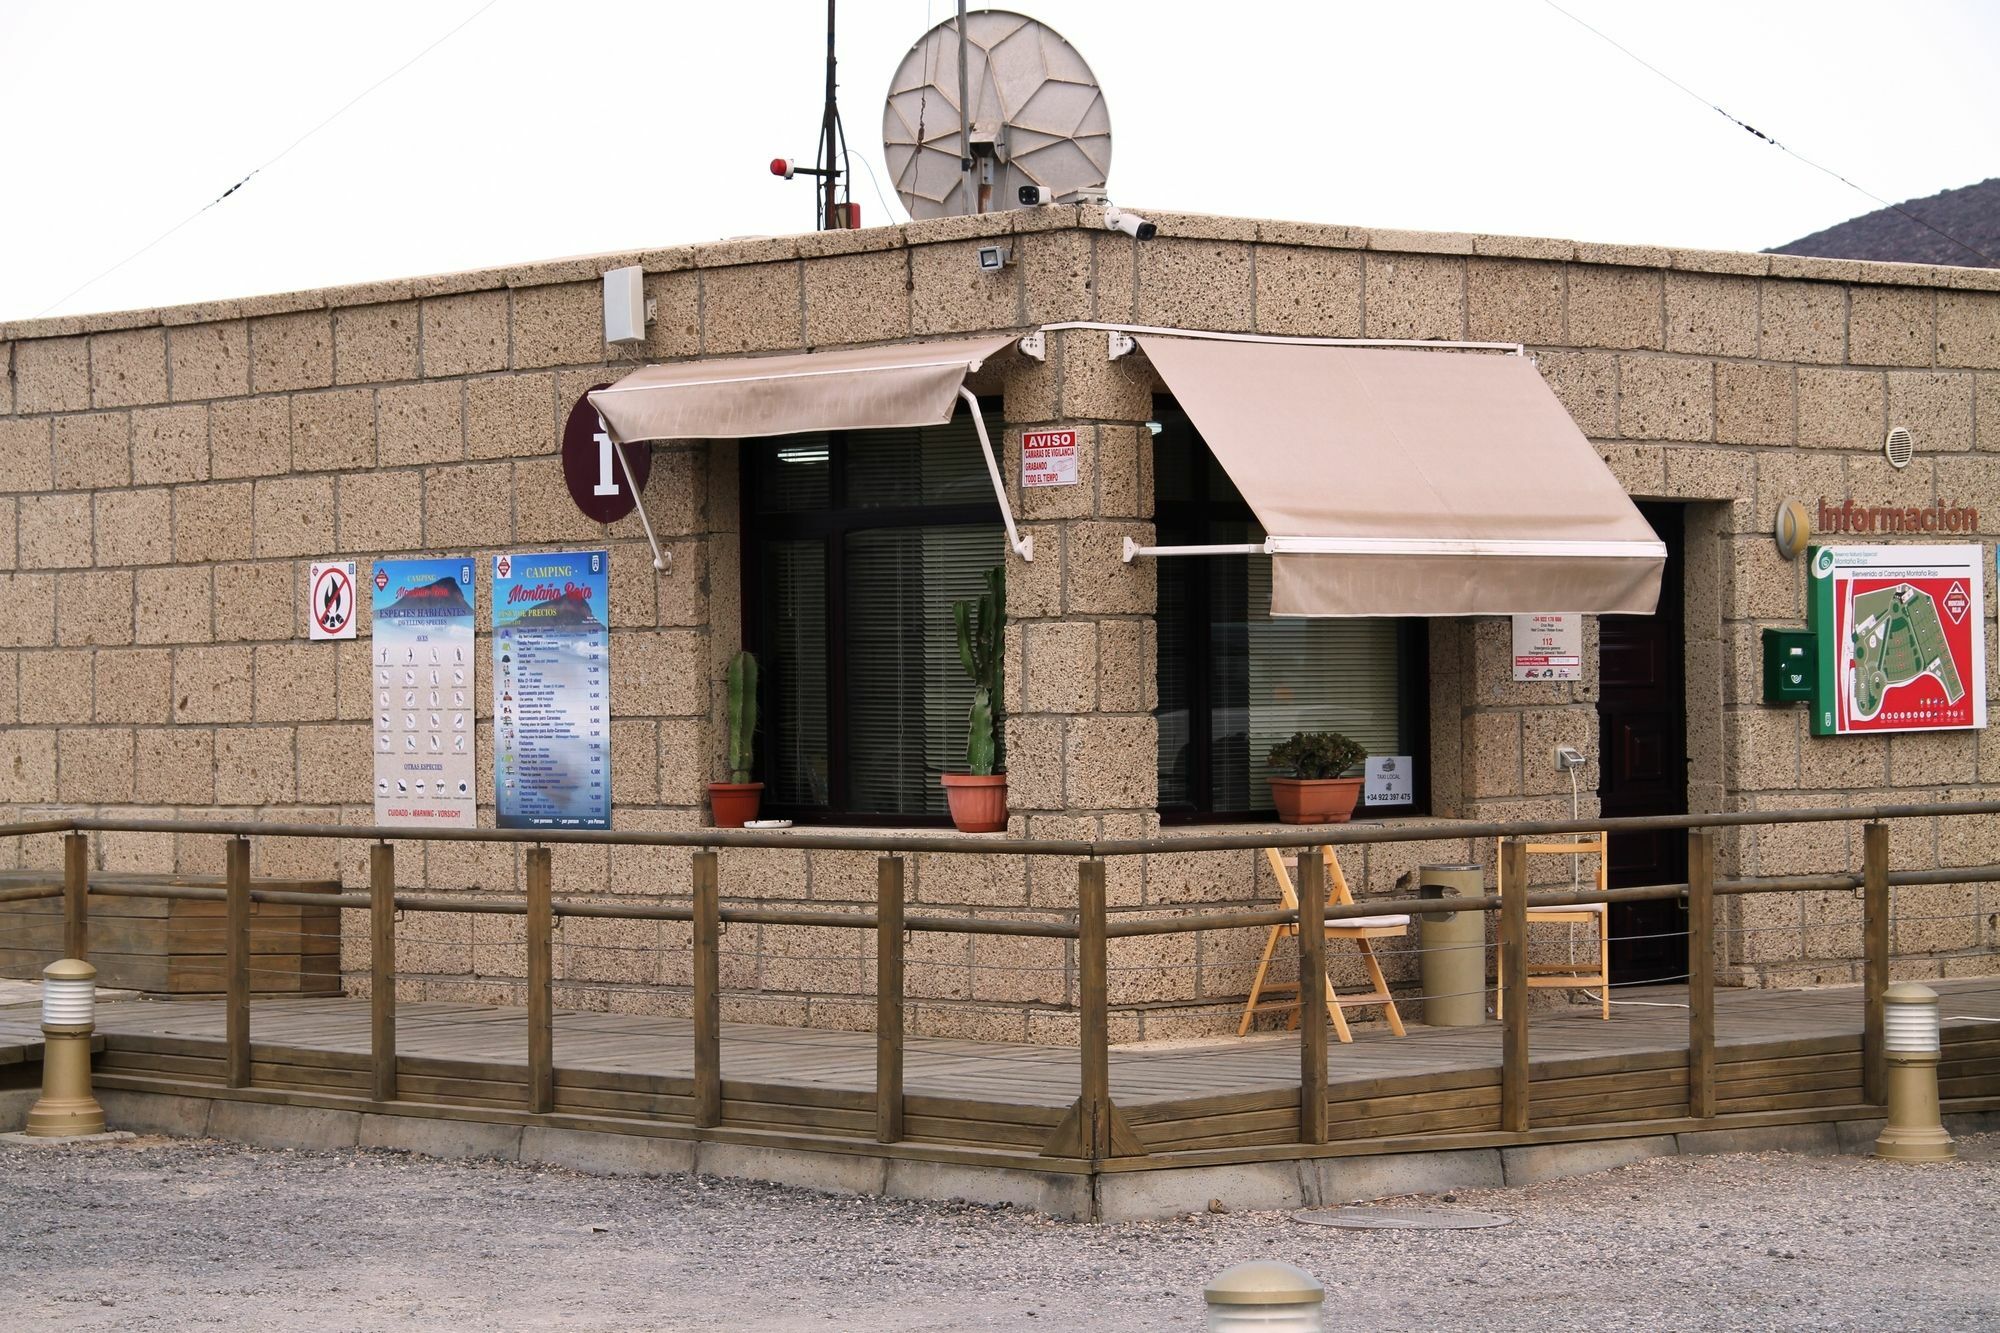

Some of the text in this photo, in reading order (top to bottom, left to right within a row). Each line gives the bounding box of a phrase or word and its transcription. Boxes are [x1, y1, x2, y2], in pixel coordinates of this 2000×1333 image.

[1028, 433, 1071, 448] AVISO
[1025, 447, 1074, 459] CAMARAS DE VIGILANCIA
[1025, 461, 1048, 471] GRABANDO
[1025, 472, 1059, 483] TODO EL TIEMPO
[1818, 496, 1979, 532] Información
[1856, 557, 1868, 566] Roja
[526, 565, 573, 578] CAMPING
[1883, 570, 1906, 579] Camping
[507, 581, 592, 604] Montaña Roja
[379, 607, 466, 618] ESPECIES HABITANTES
[527, 608, 557, 617] PRECIOS
[1542, 637, 1553, 646] 112
